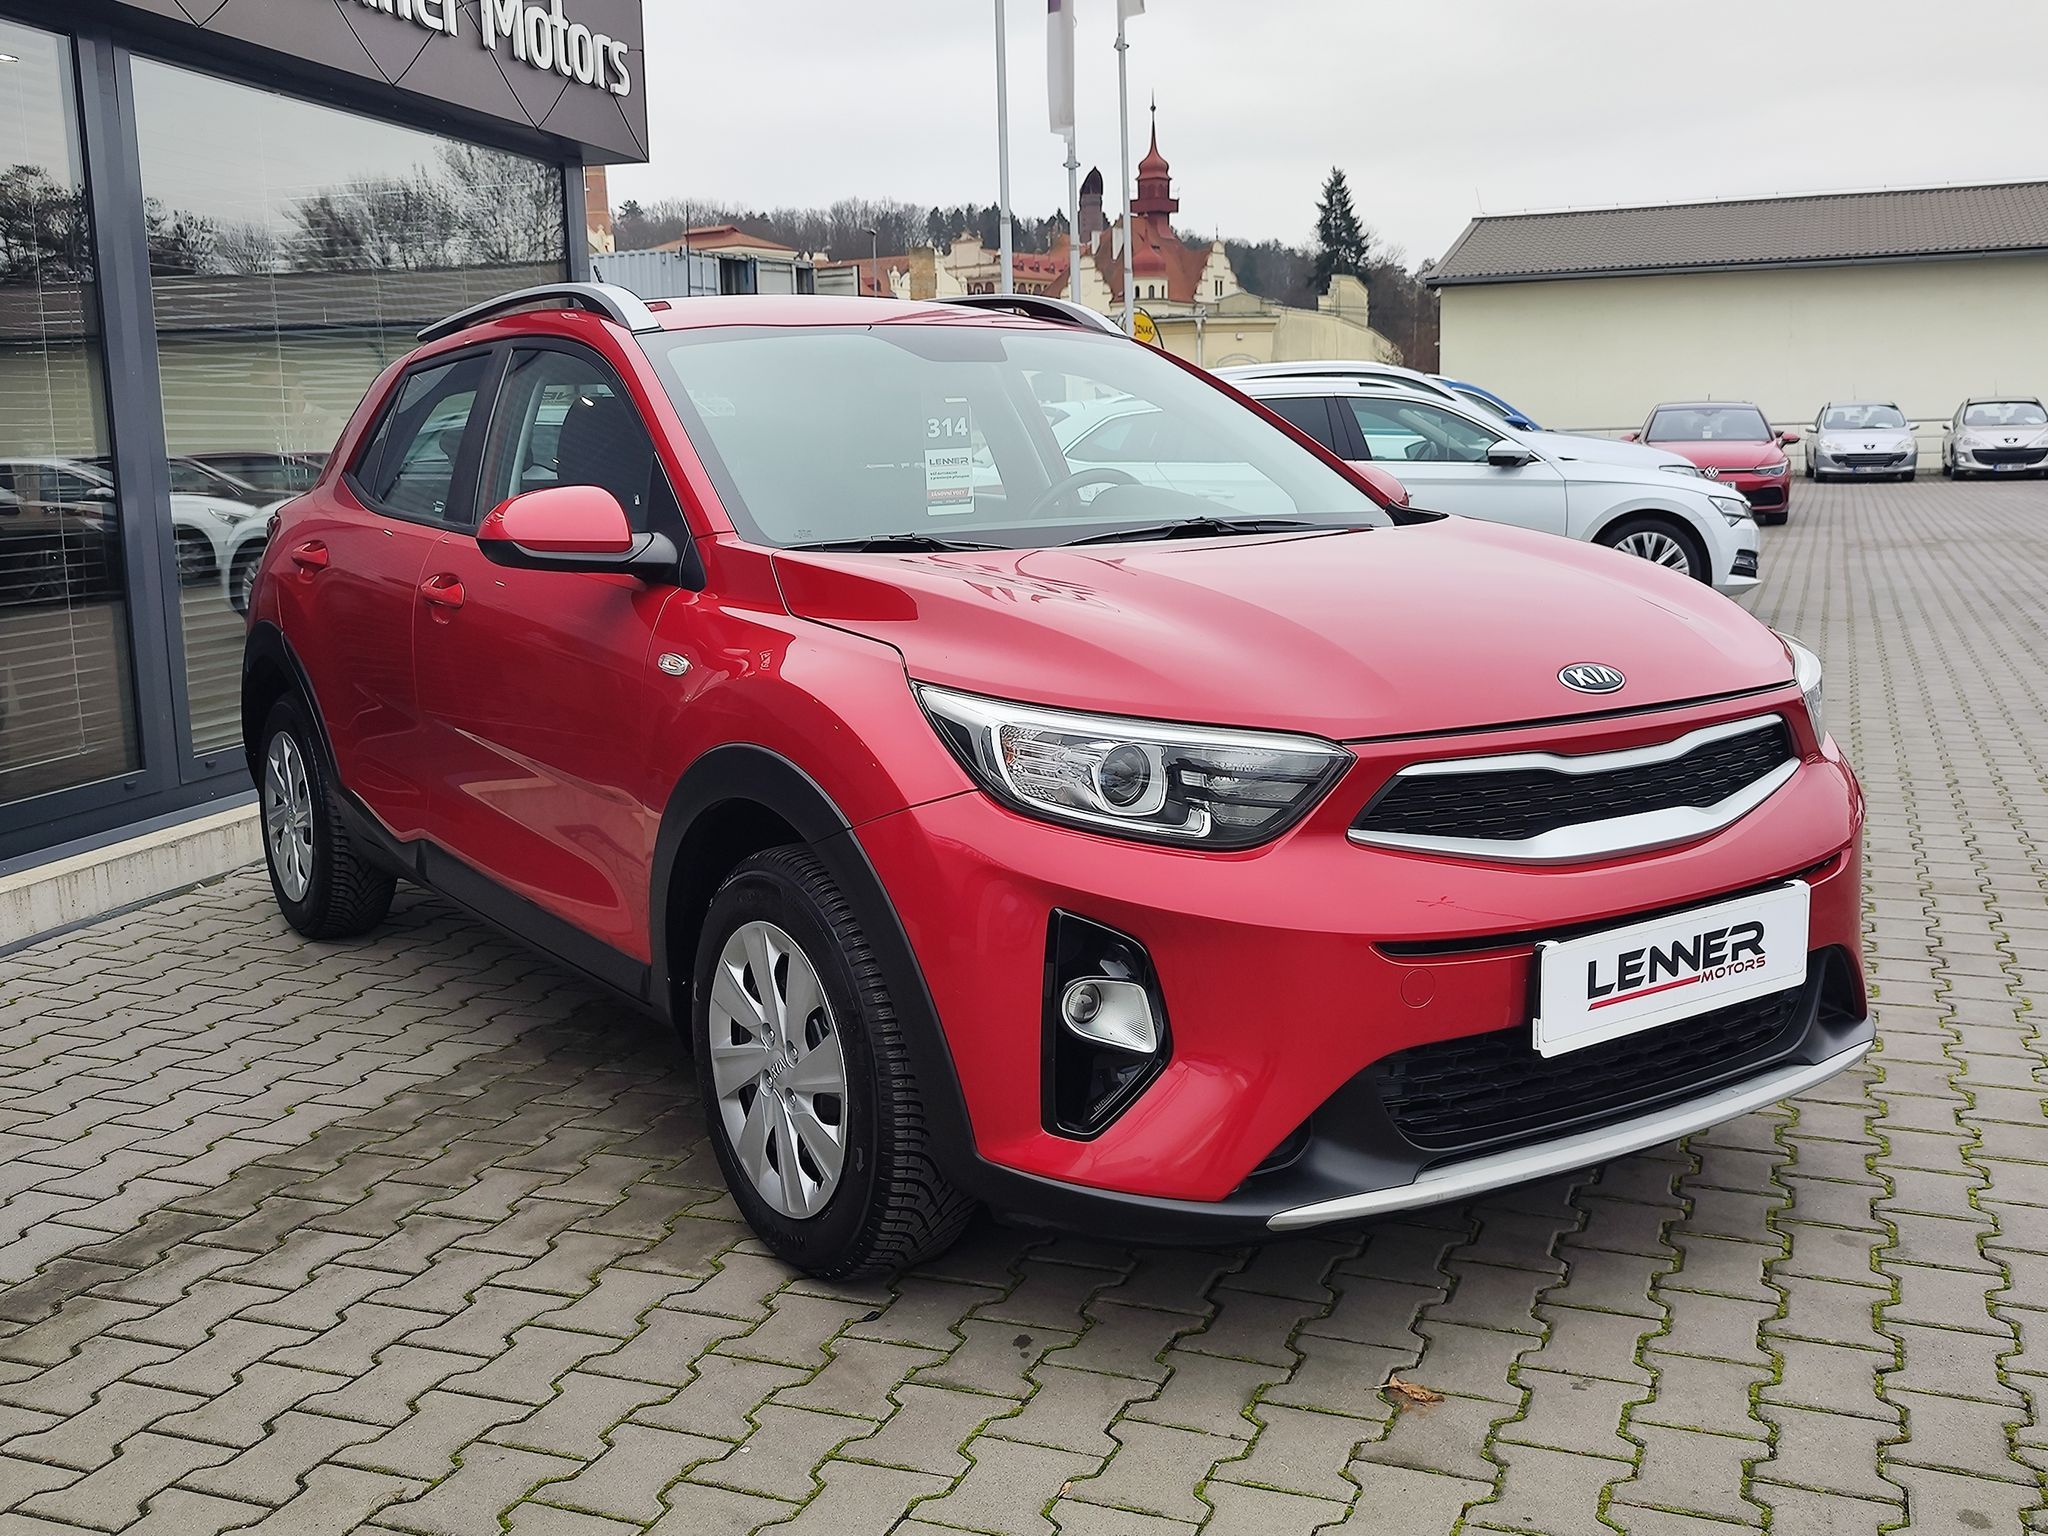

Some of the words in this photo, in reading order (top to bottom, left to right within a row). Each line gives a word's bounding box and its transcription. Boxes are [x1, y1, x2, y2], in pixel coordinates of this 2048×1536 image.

[480, 0, 632, 98] Motors
[927, 417, 968, 438] 314
[929, 457, 969, 466] LENNER
[1567, 666, 1620, 686] KIA
[1587, 920, 1767, 1000] LENNER
[1700, 955, 1767, 984] MOTORS
